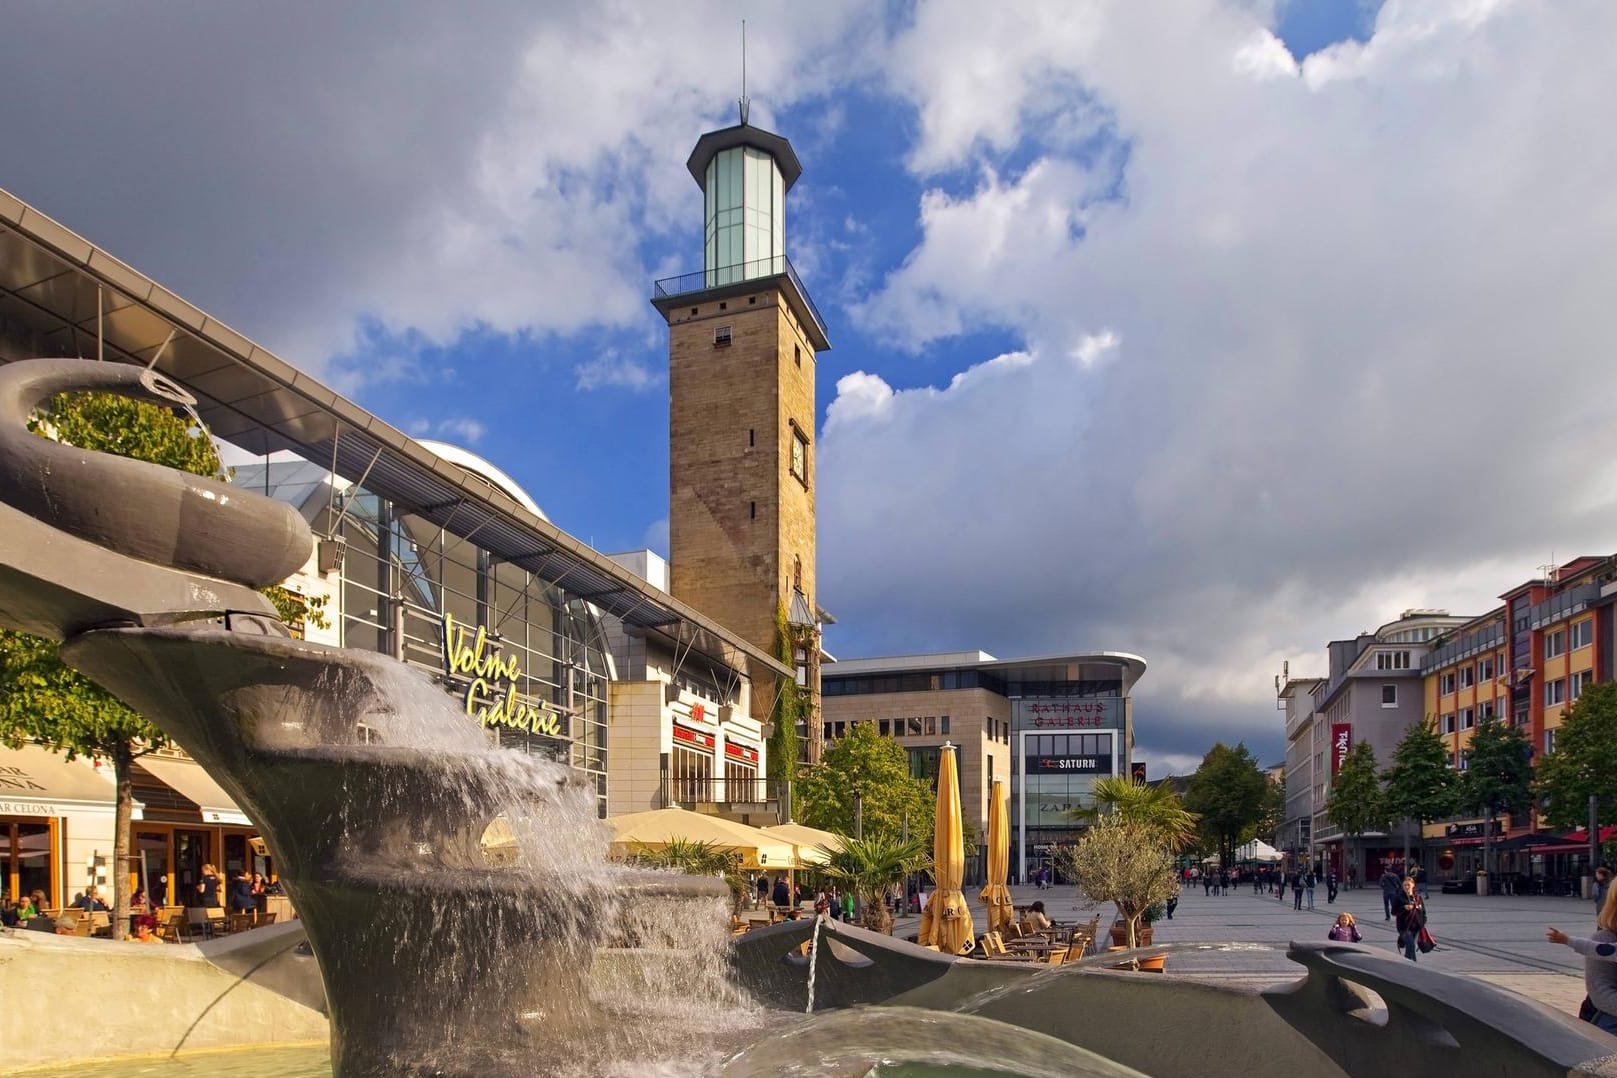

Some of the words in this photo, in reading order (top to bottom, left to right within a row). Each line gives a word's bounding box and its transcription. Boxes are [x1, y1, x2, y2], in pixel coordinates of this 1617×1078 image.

[445, 612, 521, 681] Volme
[466, 677, 561, 736] Galerie
[1031, 702, 1104, 713] RATHAUS
[1034, 717, 1103, 727] GALERIE
[1059, 760, 1095, 768] SATURN
[14, 804, 56, 814] CELONA
